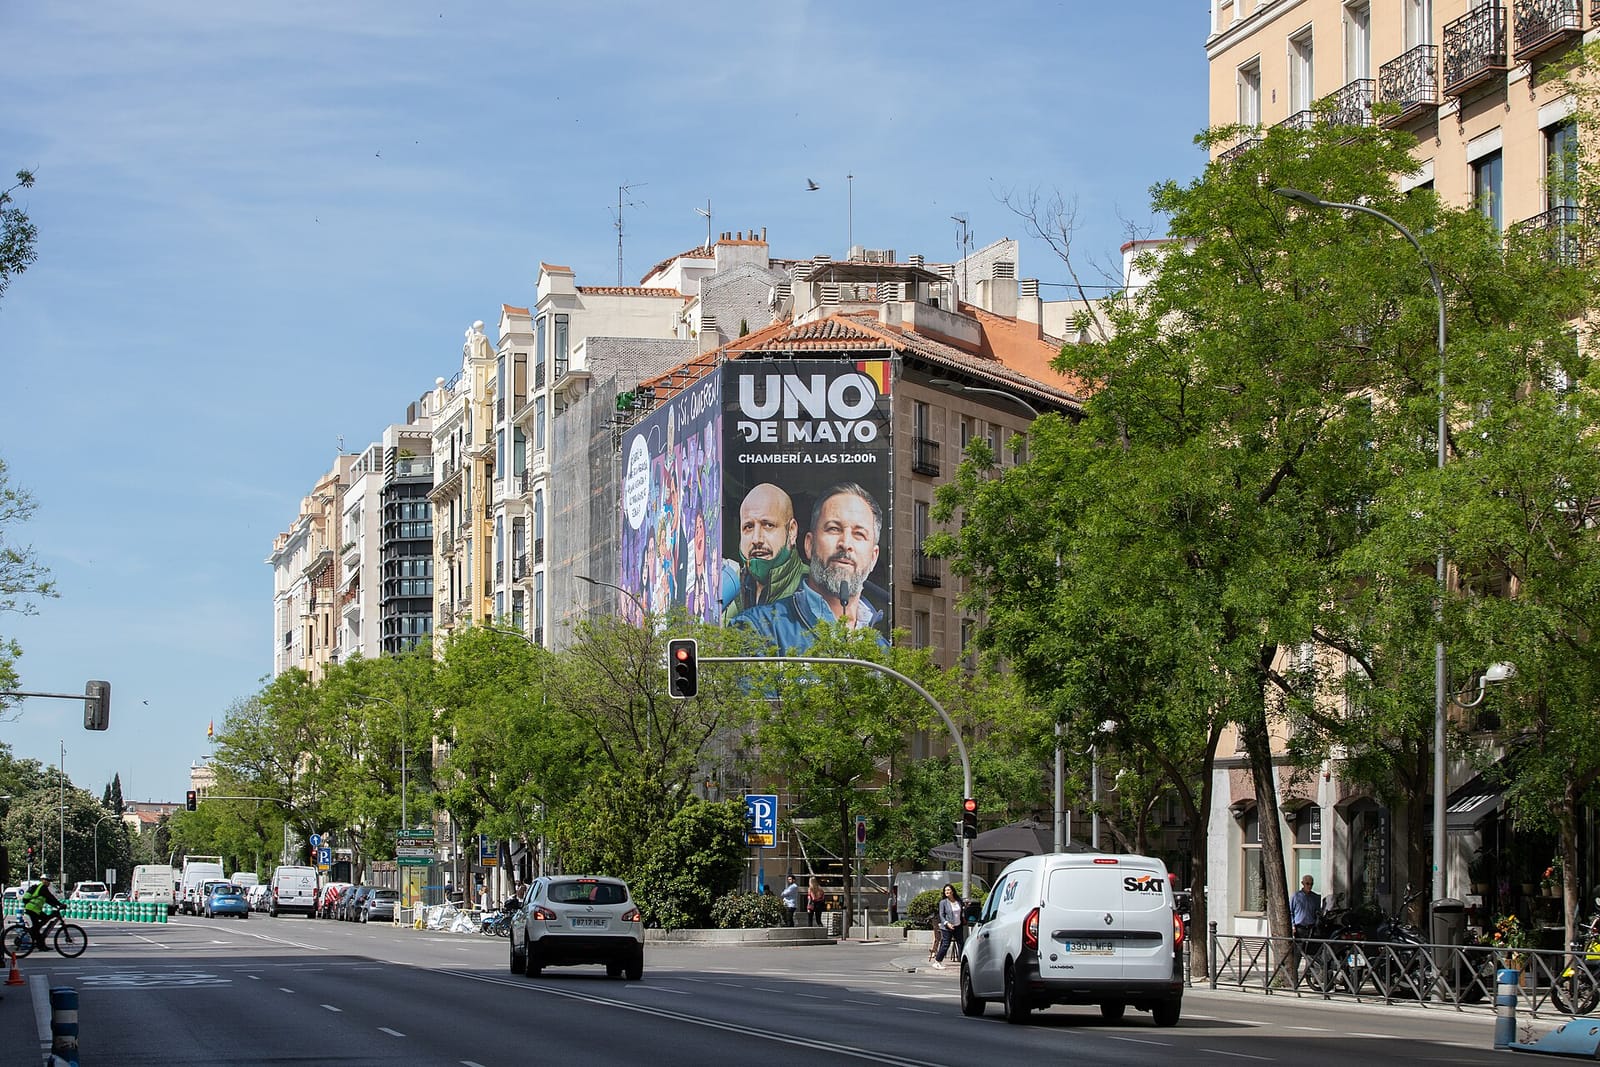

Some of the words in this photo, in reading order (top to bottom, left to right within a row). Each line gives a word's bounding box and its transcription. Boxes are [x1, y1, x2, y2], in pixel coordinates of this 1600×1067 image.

[738, 373, 876, 420] UNO
[737, 421, 778, 443] DE
[788, 420, 877, 443] MAYO
[738, 451, 800, 463] CHAMBERÍ
[803, 454, 813, 463] A
[815, 454, 837, 463] LAS
[839, 453, 877, 463] 12:00h
[1071, 942, 1093, 951] 3901
